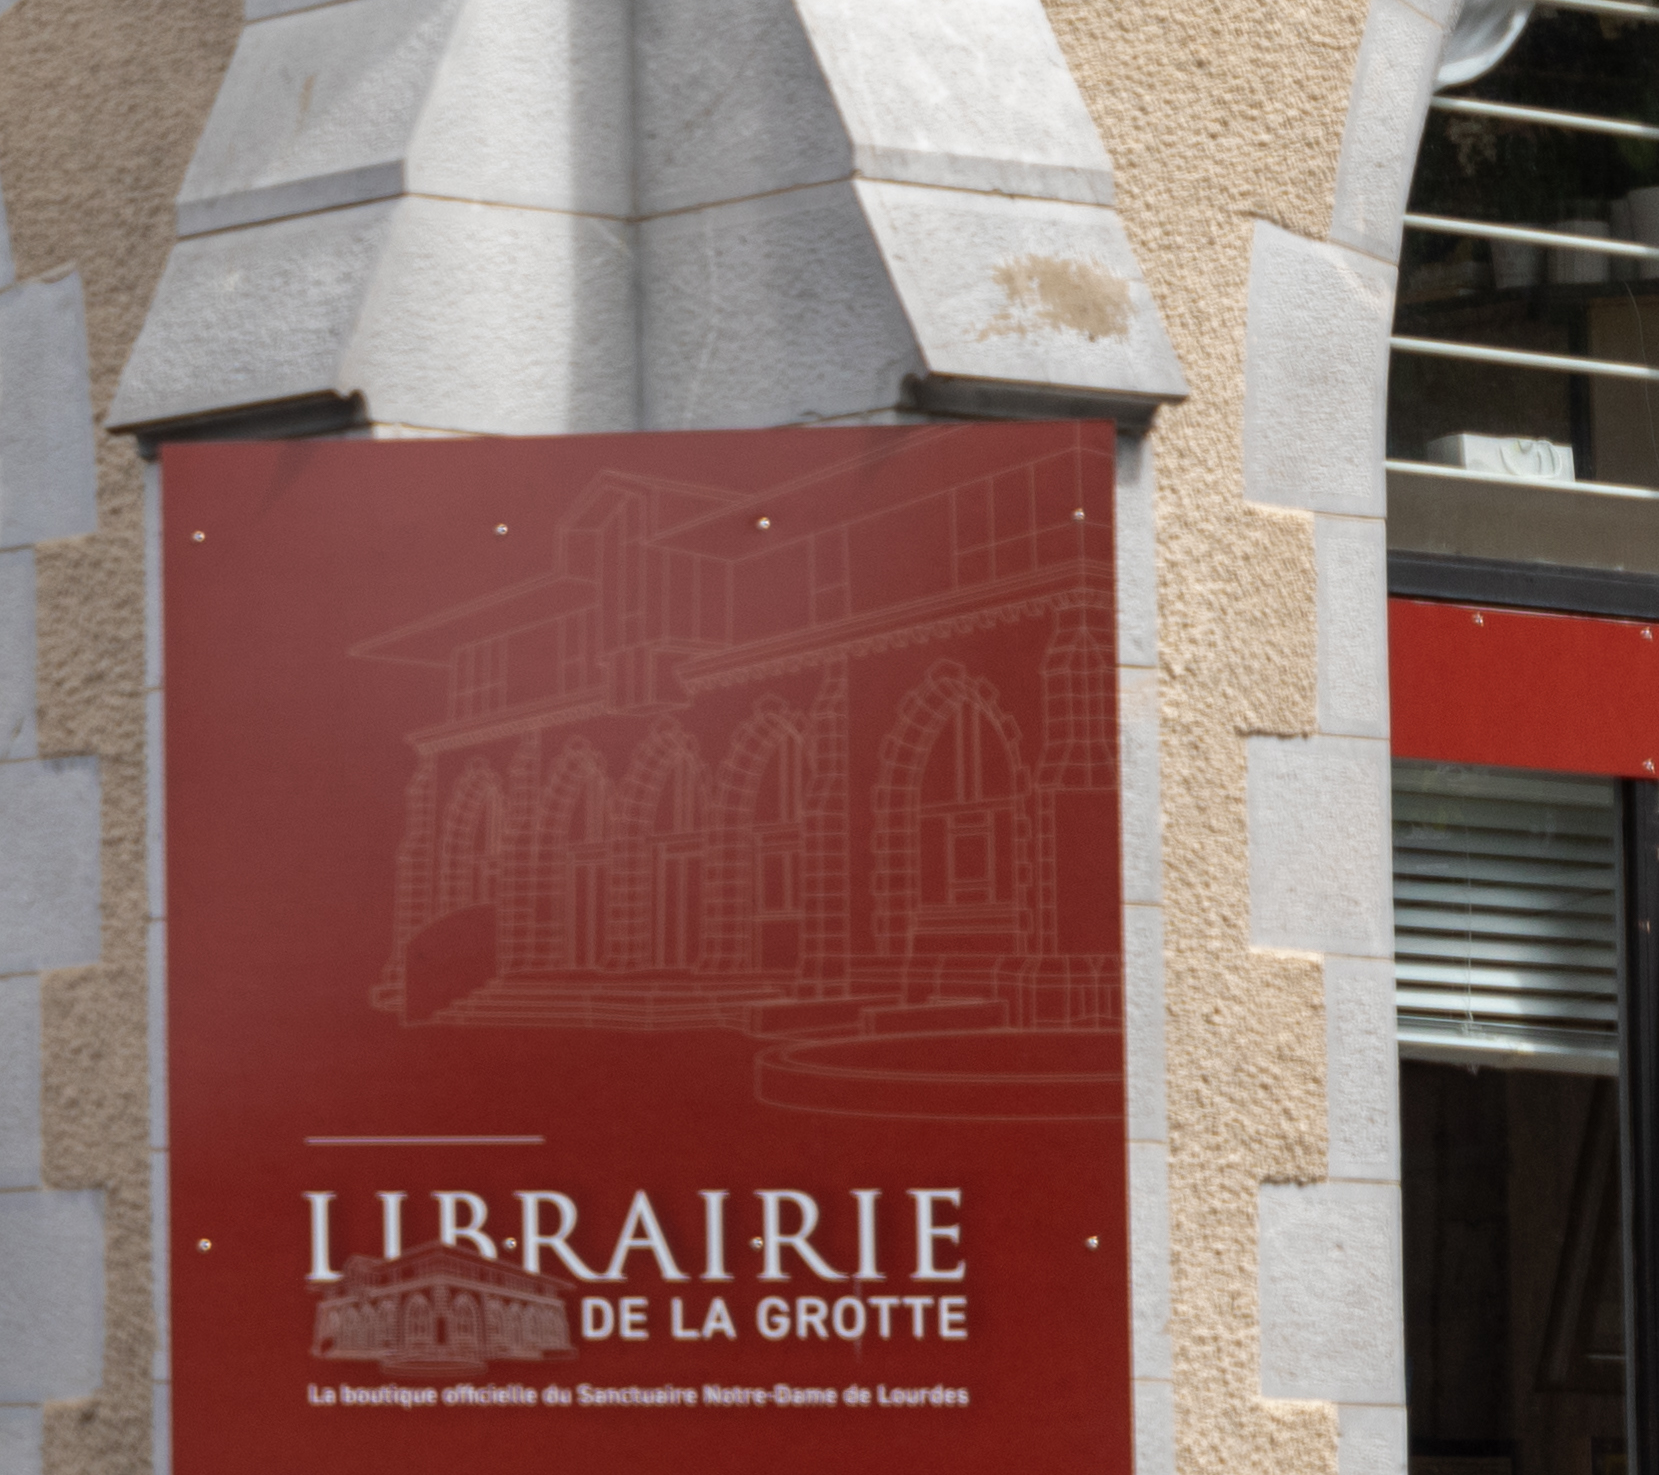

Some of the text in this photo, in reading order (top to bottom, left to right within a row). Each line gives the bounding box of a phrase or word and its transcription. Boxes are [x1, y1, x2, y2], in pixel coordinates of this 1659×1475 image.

[303, 1189, 966, 1282] LIBRAIRIE
[581, 1295, 968, 1339] DE LA GROTTE
[308, 1383, 969, 1408] La boutique officielle du Sanctuaire Notre-Dame de Lourdes
